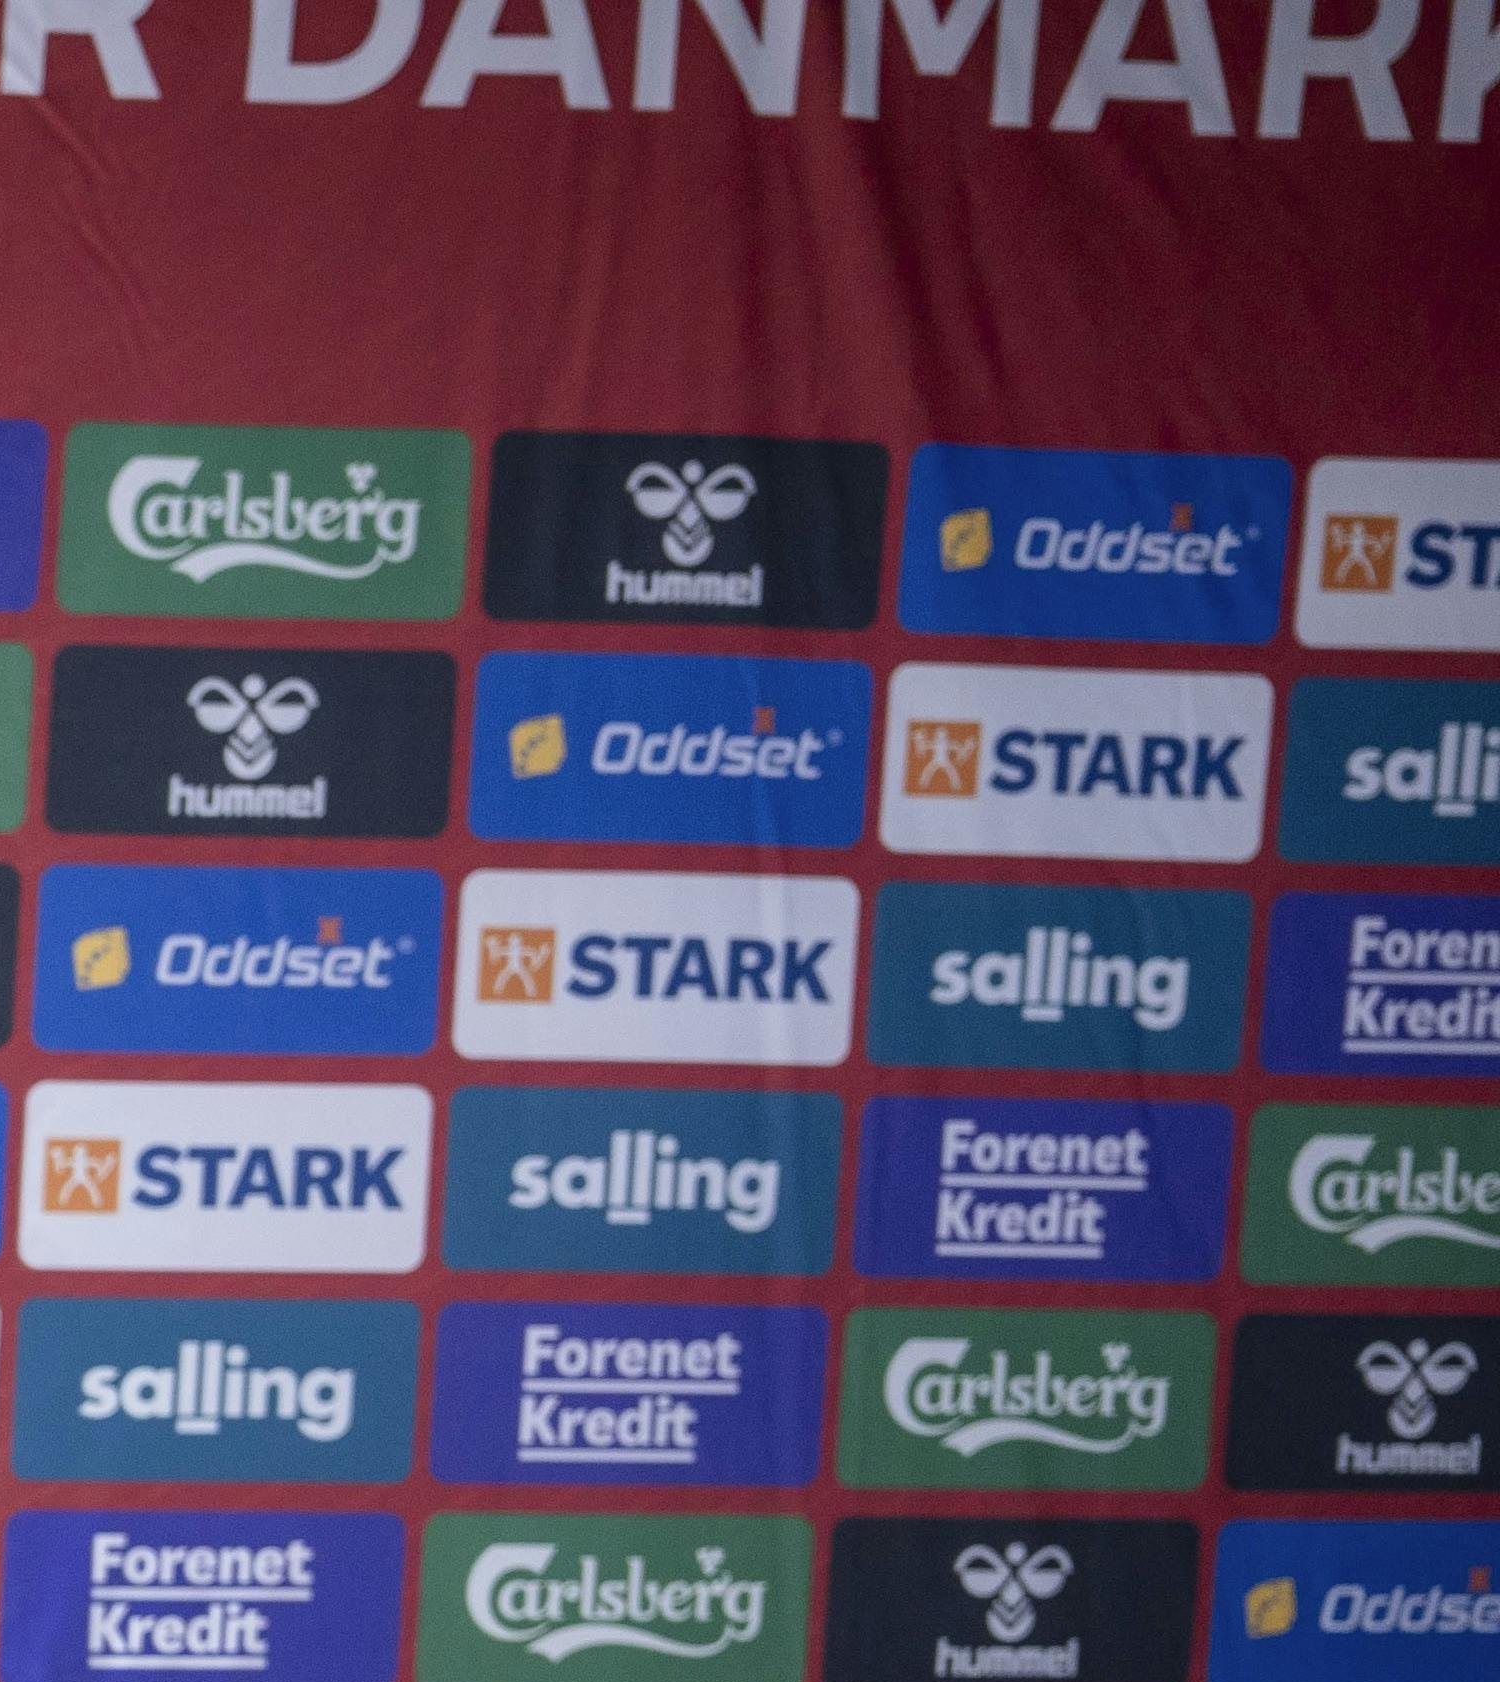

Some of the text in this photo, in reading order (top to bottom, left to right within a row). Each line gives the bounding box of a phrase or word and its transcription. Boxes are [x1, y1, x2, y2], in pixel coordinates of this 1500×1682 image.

[107, 455, 420, 583] Carlsberg
[605, 560, 763, 607] hummel
[989, 728, 1245, 801] STARK
[167, 775, 327, 819] hummel
[566, 933, 832, 1004] STARK
[930, 926, 1189, 1031] salling
[940, 1117, 1148, 1176] Forenet
[936, 1189, 1103, 1243] Kredit
[522, 1325, 738, 1378] Forenet
[79, 1340, 355, 1441] salling
[518, 1395, 695, 1447] Kredit
[1336, 1435, 1481, 1474] hummel
[88, 1532, 313, 1588] Forenet
[88, 1601, 266, 1654] Kredit
[464, 1542, 765, 1662] Carlsberg
[934, 1638, 1079, 1678] hummel
